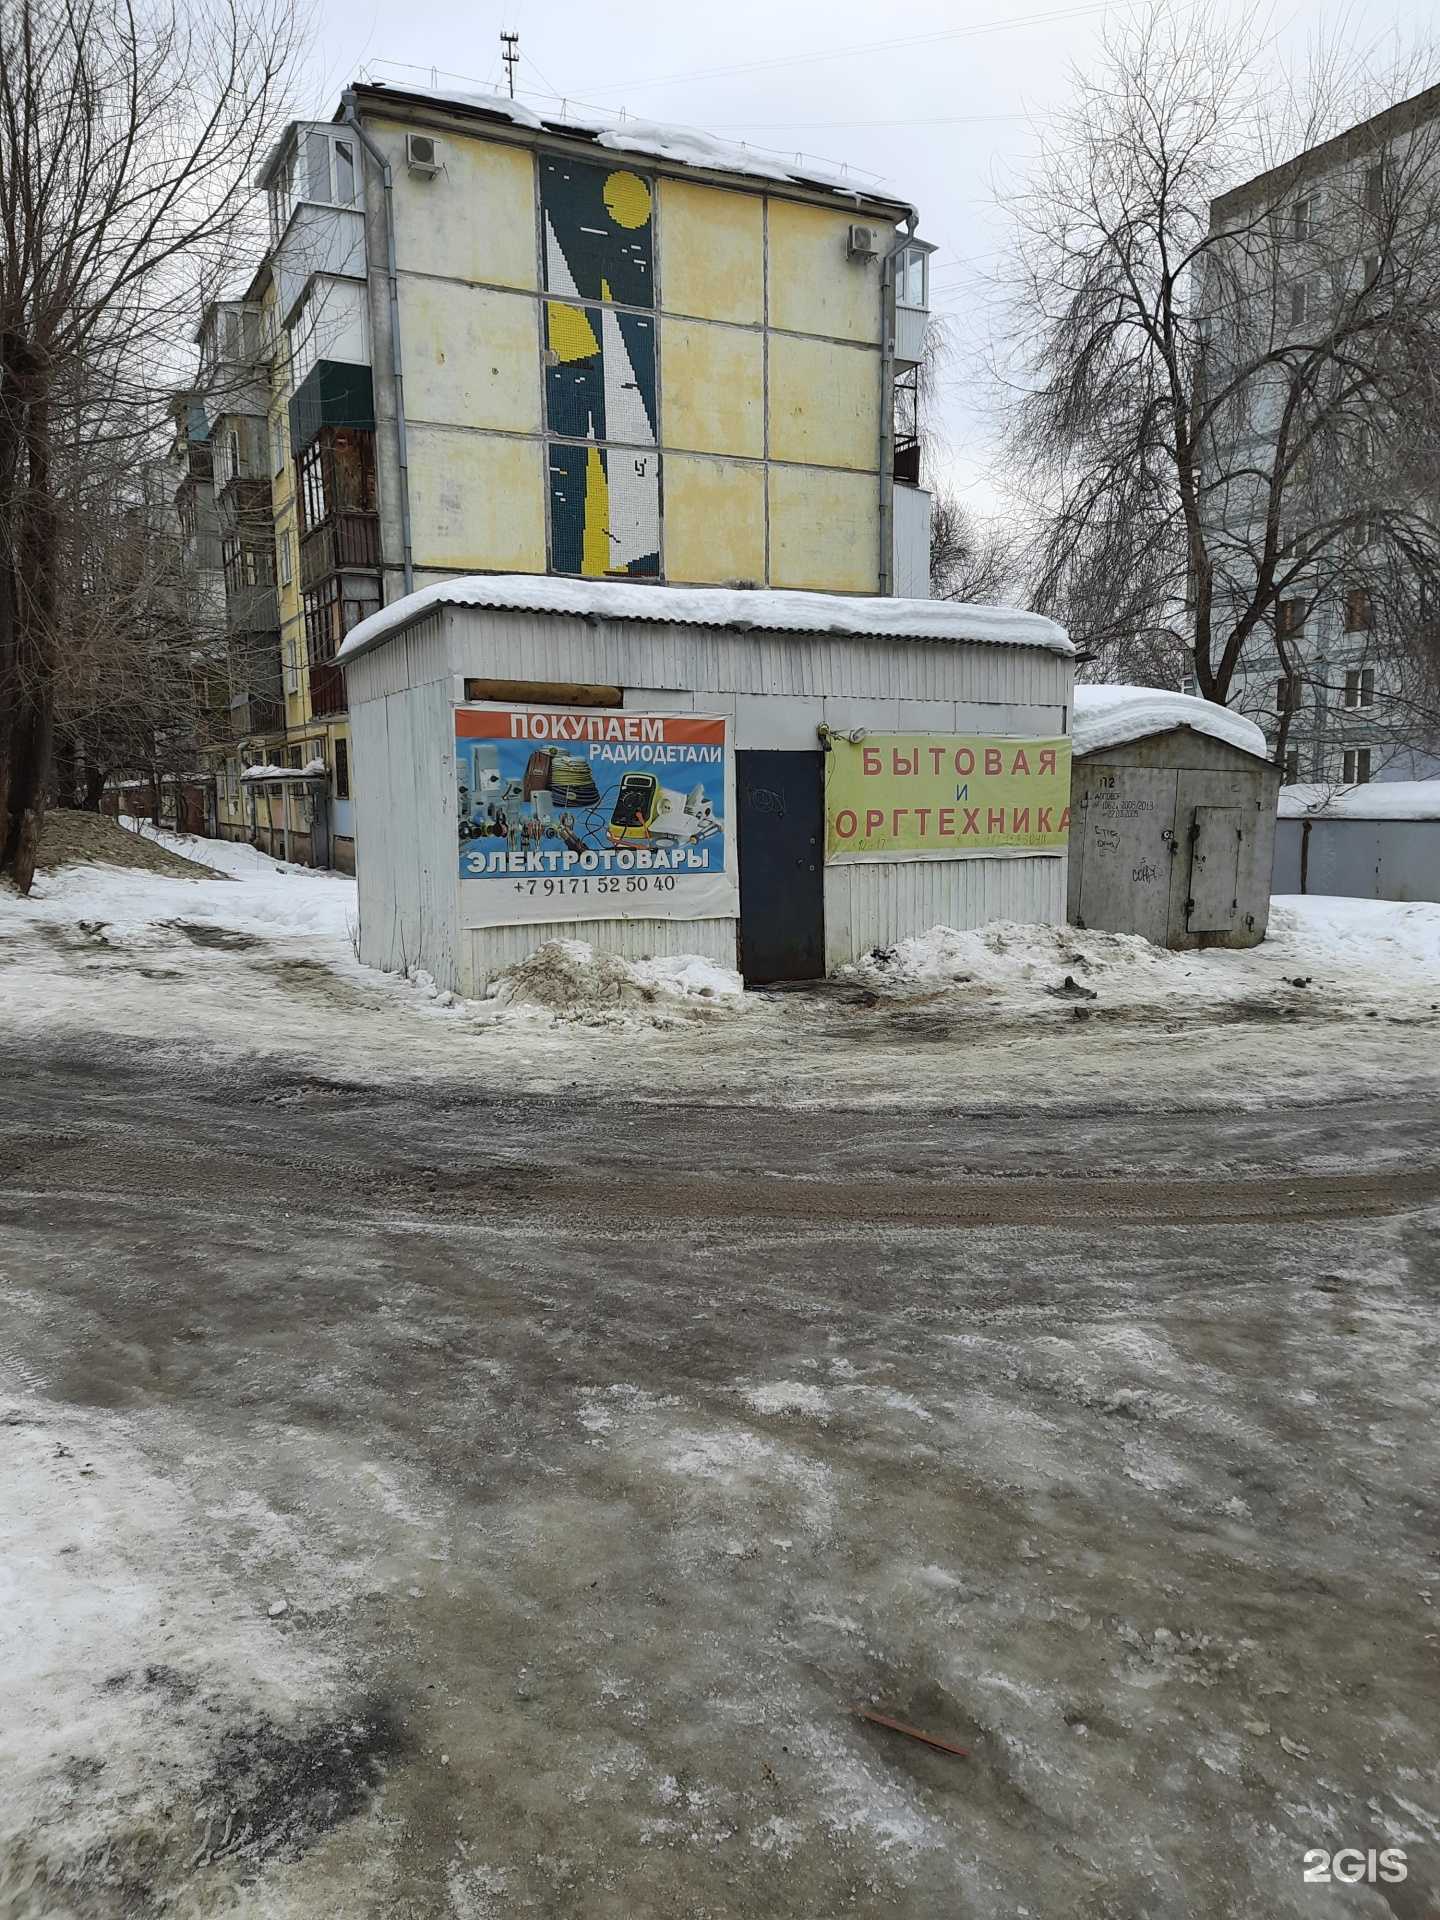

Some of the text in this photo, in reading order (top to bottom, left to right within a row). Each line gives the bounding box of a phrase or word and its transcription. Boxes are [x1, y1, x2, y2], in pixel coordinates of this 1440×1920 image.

[510, 713, 664, 742] ПОКУПАЕМ
[589, 743, 722, 765] РАДИОДЕТАЛИ
[863, 747, 1056, 776] БЫТОВАЯ
[956, 783, 968, 801] И
[835, 806, 1072, 838] ОРГТЕХНИКА
[466, 848, 709, 873] ЭЛЕКТРОТОВАРЫ
[513, 879, 537, 895] +7
[597, 878, 620, 893] 52
[626, 876, 648, 891] 50
[653, 875, 676, 891] 40
